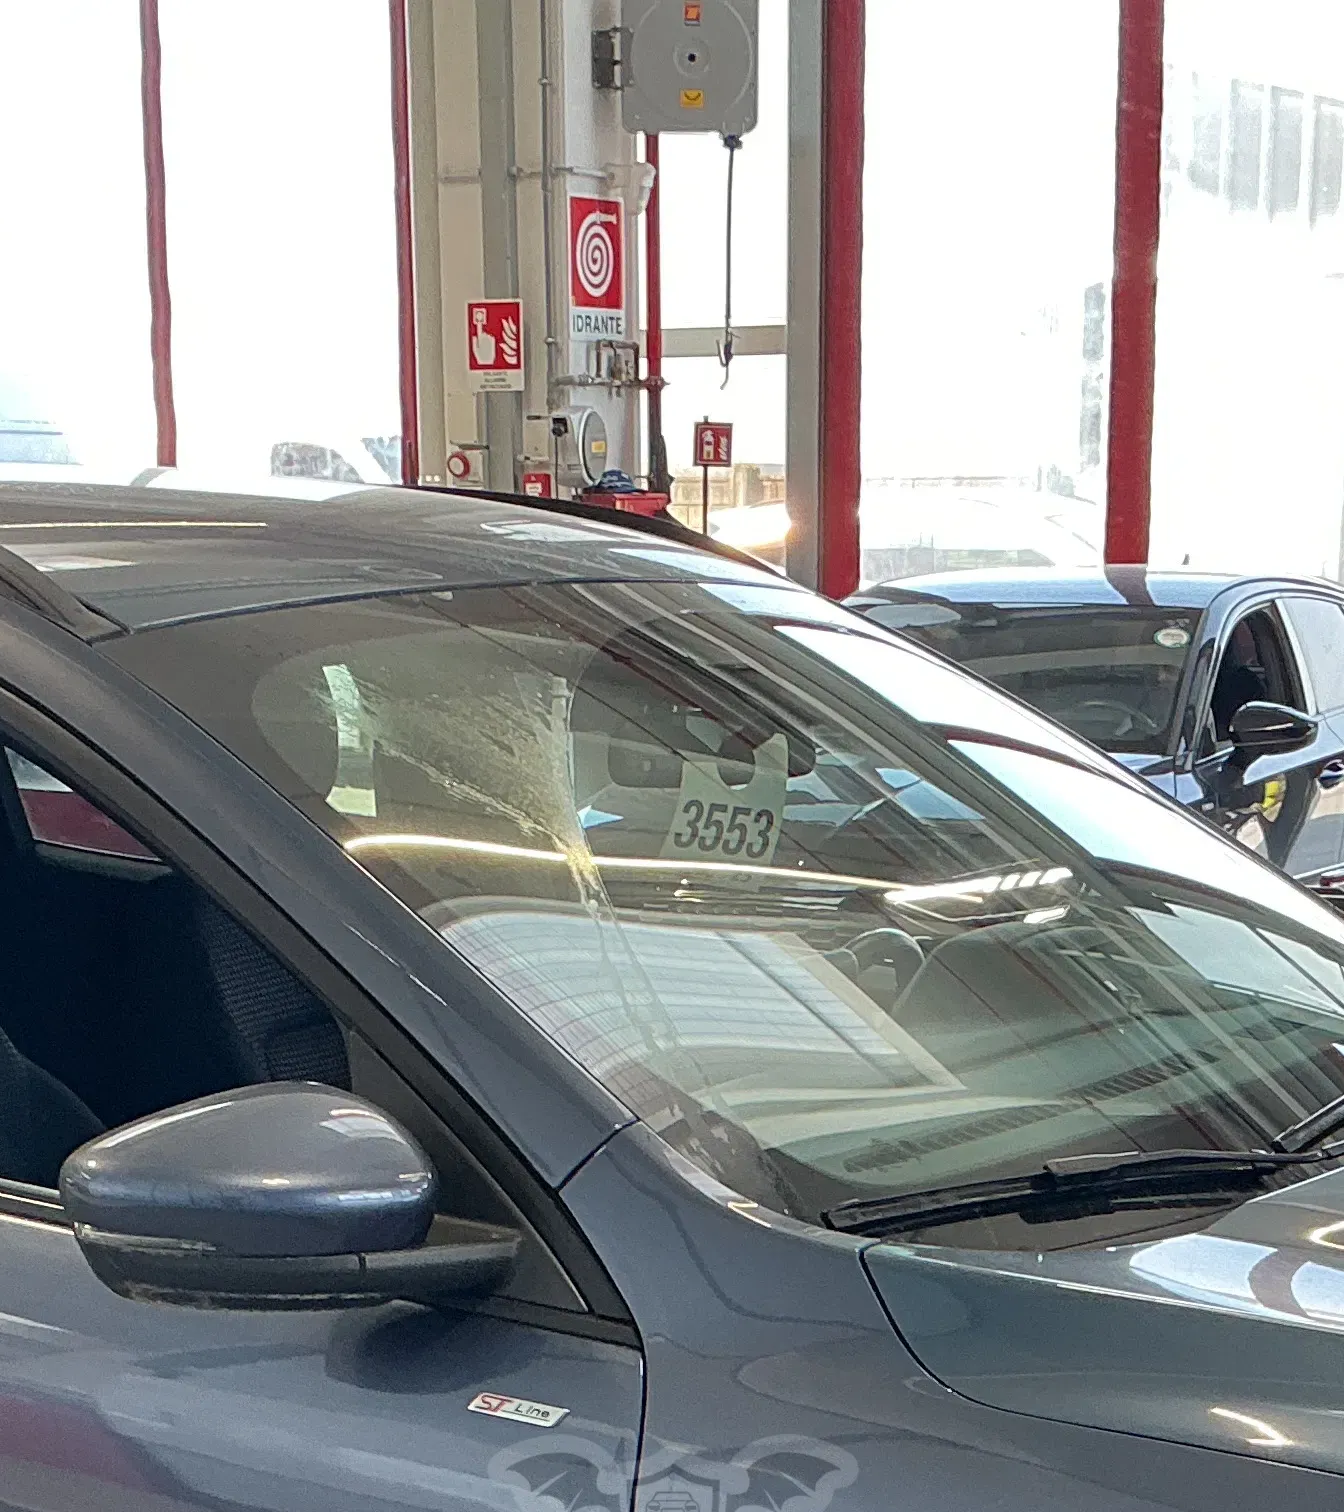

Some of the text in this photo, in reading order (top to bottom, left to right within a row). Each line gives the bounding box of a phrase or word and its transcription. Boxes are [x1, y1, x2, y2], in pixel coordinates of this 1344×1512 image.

[572, 314, 623, 335] IDRANTE
[673, 799, 775, 859] 3553
[475, 1394, 514, 1413] ST
